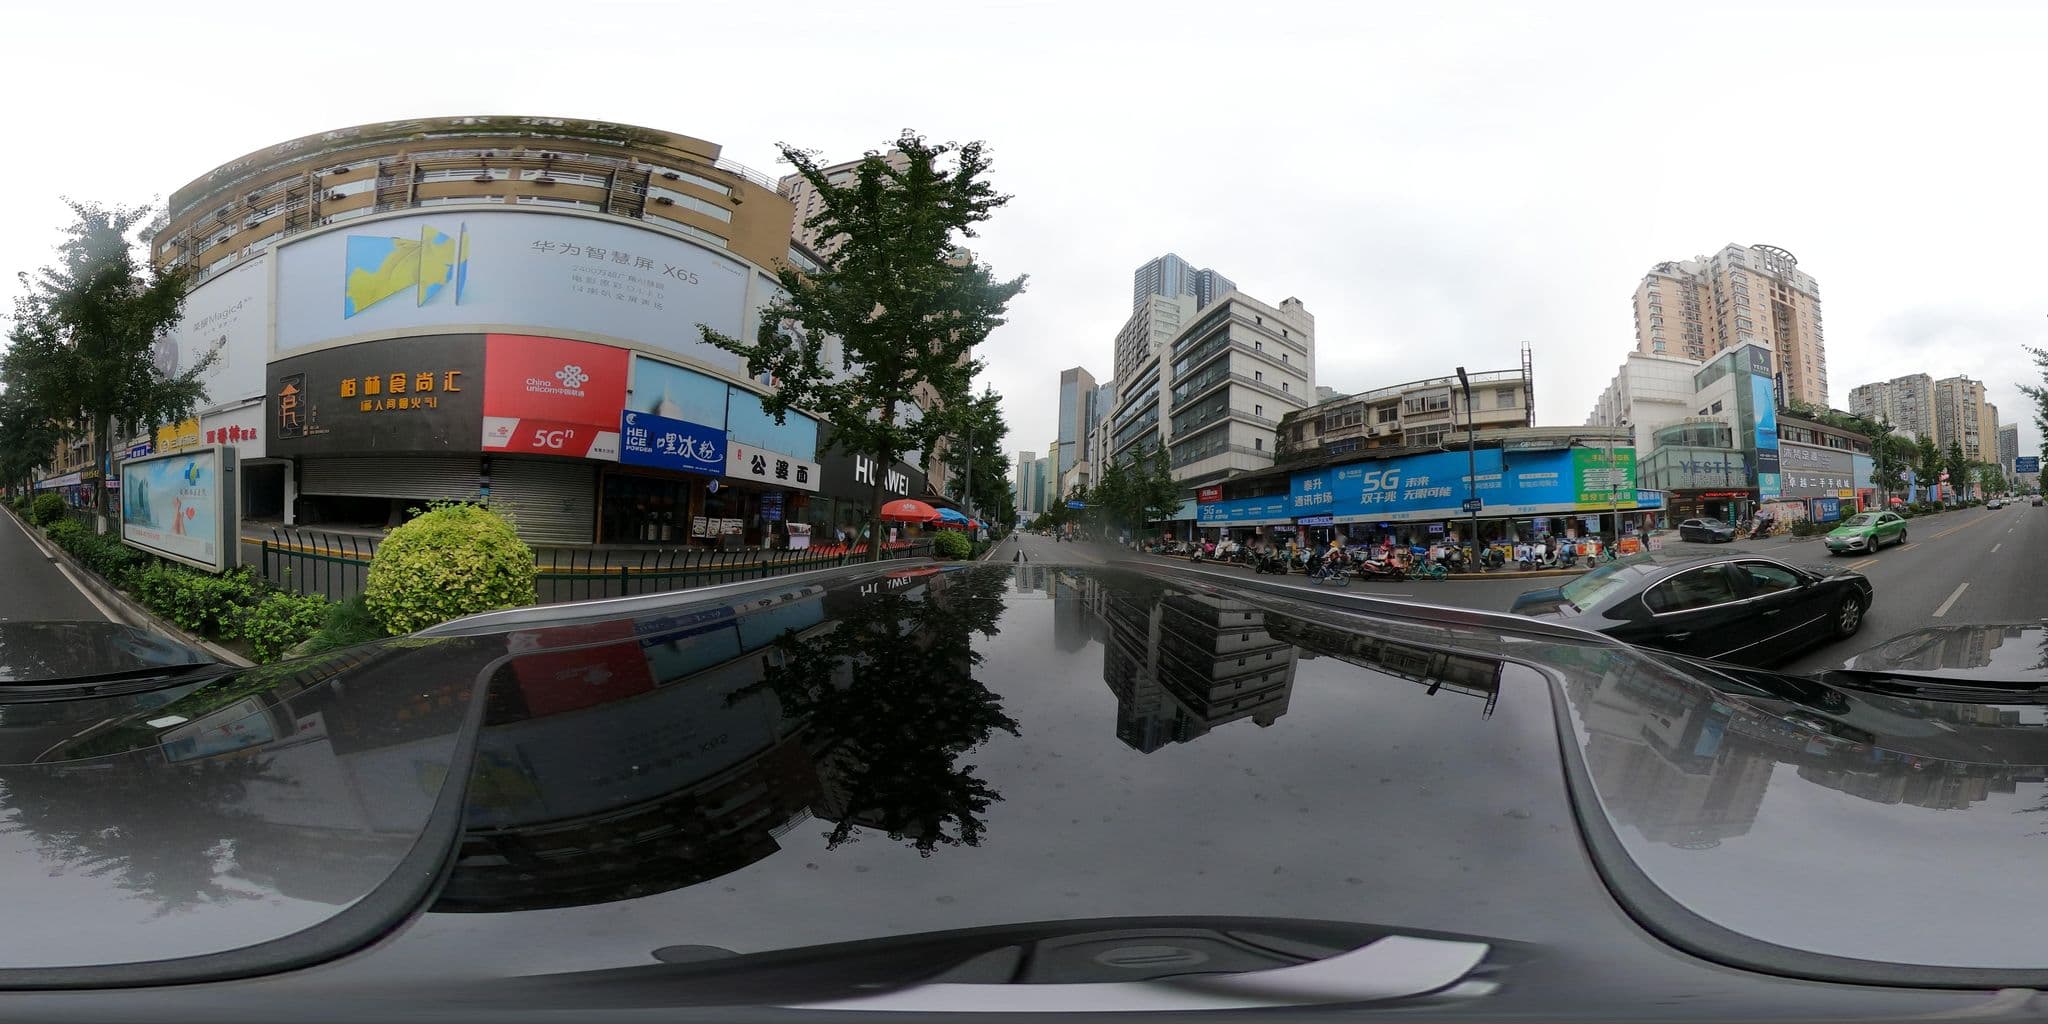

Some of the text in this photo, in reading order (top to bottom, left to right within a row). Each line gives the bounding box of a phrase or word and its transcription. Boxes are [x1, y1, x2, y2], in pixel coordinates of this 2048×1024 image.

[531, 239, 699, 285] 华为智慧屏 X65
[526, 378, 551, 387] China
[526, 386, 557, 394] unicom
[626, 427, 648, 437] HEI
[626, 437, 646, 447] ICE
[751, 455, 809, 484] 公婆面
[1680, 460, 1732, 474] YESTE
[1362, 468, 1430, 493] 5G 未来
[1295, 492, 1333, 507] 通讯市场
[1360, 486, 1453, 505] 双千兆 无限可能
[1203, 504, 1215, 514] 5G
